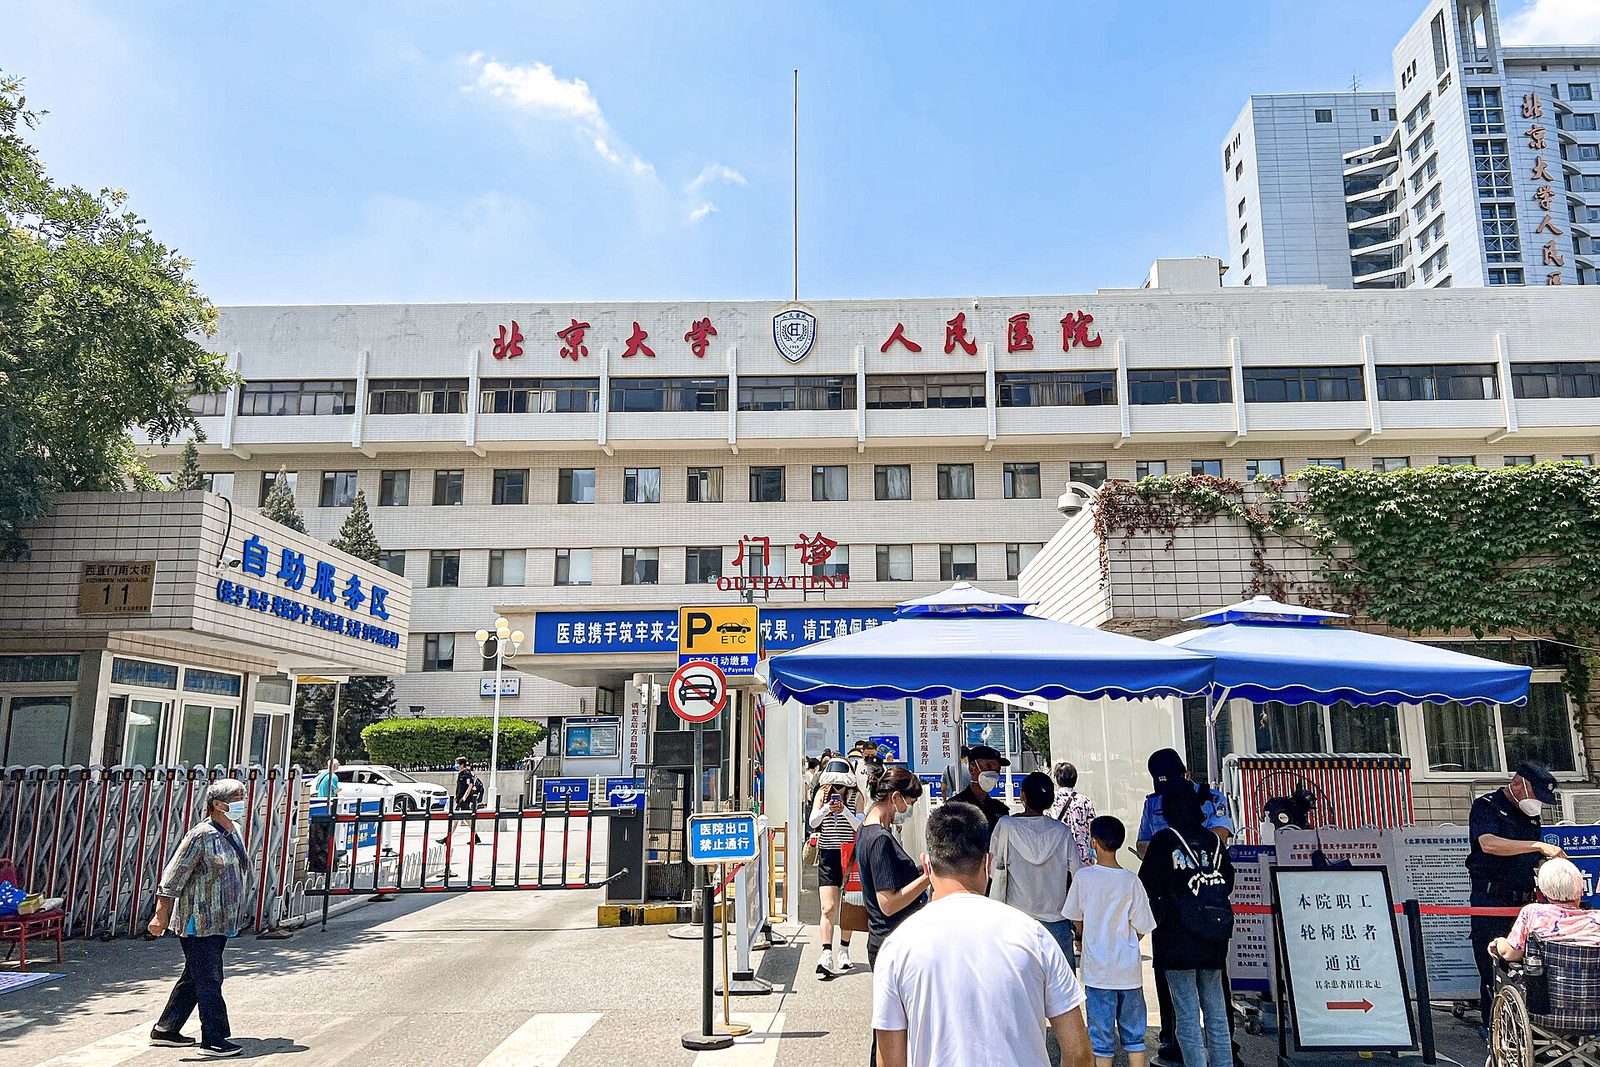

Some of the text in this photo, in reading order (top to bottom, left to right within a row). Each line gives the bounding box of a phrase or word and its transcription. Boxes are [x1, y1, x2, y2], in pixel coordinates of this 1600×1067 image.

[492, 318, 718, 361] 北京大学
[880, 311, 1102, 355] 人民医院
[732, 532, 838, 567] 门诊
[86, 564, 152, 576] 西直门南大街
[242, 535, 391, 621] 自助服务区
[717, 575, 850, 591] OUTPATIENT
[103, 584, 129, 605] 11
[556, 622, 679, 645] 医患携手筑牢来之
[687, 612, 712, 648] P
[721, 635, 746, 644] ETC
[552, 785, 581, 793] 门诊入口
[700, 823, 748, 835] 医院出口
[700, 837, 749, 851] 禁止通行
[1563, 834, 1599, 846] 北京大学
[1298, 893, 1372, 910] 本院职工
[1300, 924, 1377, 941] 轮椅患者
[1325, 955, 1361, 971] 通道
[1315, 980, 1382, 989] 其余患者请往北走
